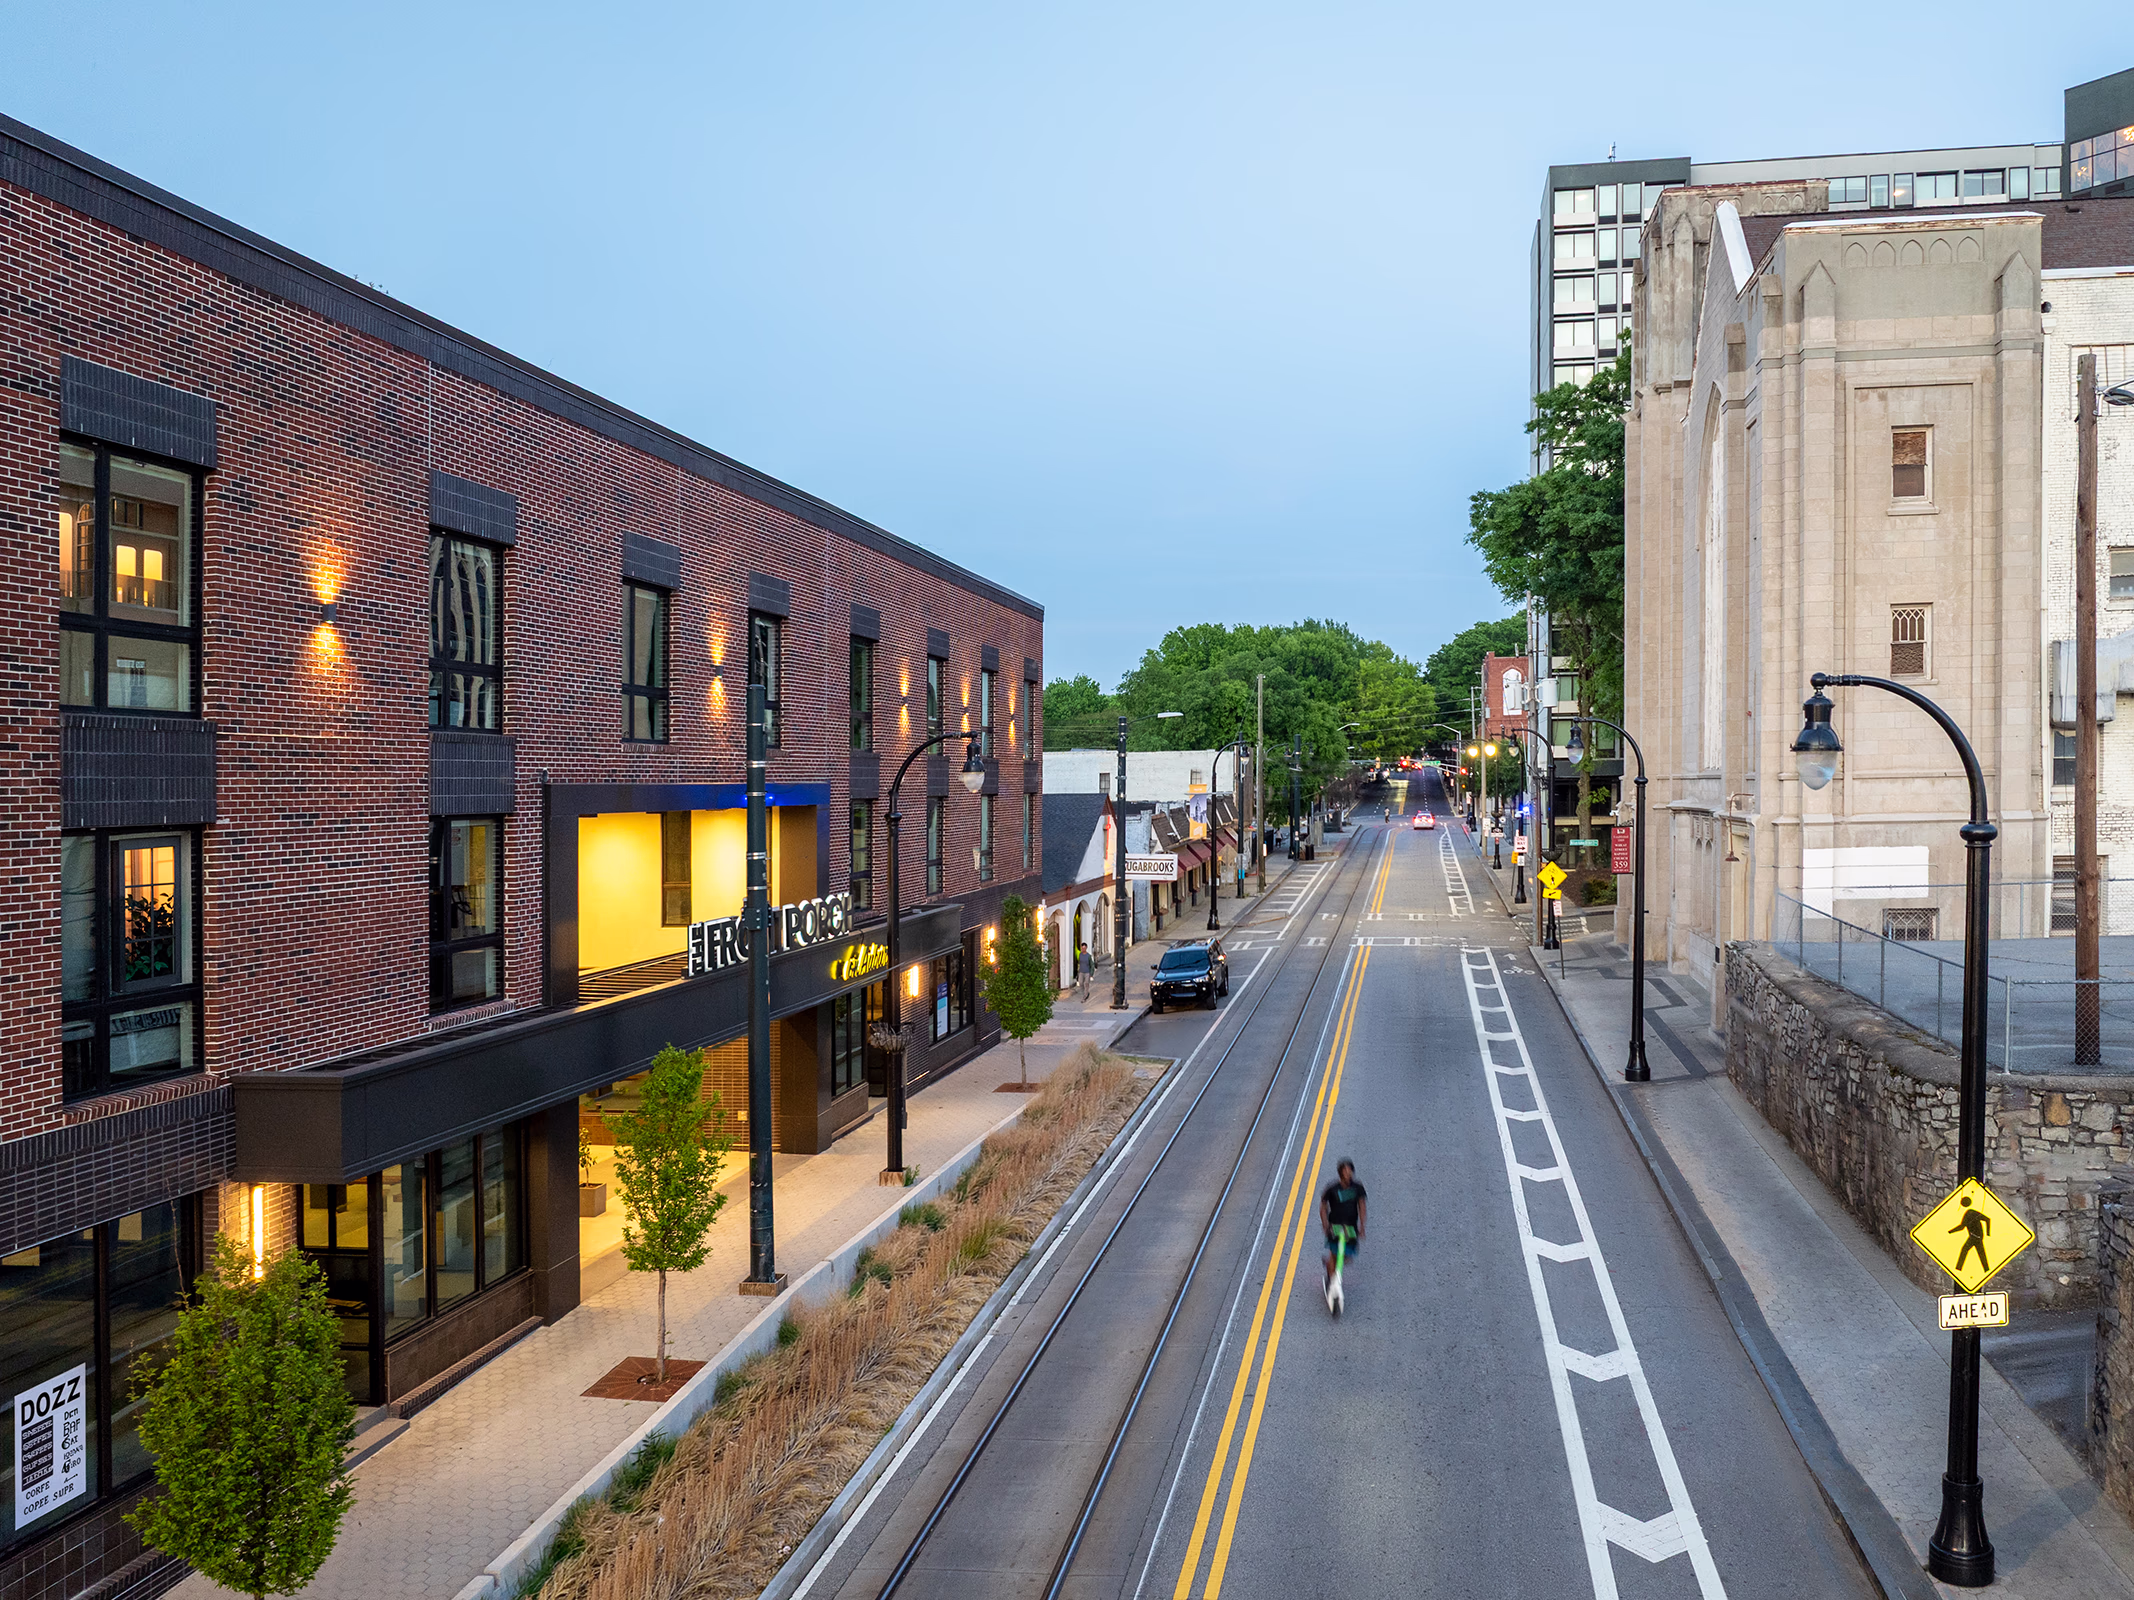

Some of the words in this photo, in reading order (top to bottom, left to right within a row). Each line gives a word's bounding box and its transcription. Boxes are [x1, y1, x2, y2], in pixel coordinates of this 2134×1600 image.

[1614, 861, 1628, 869] 359
[782, 891, 854, 952] PORCH
[1949, 1302, 1999, 1319] AHEAD
[21, 1376, 80, 1427] DOZZ
